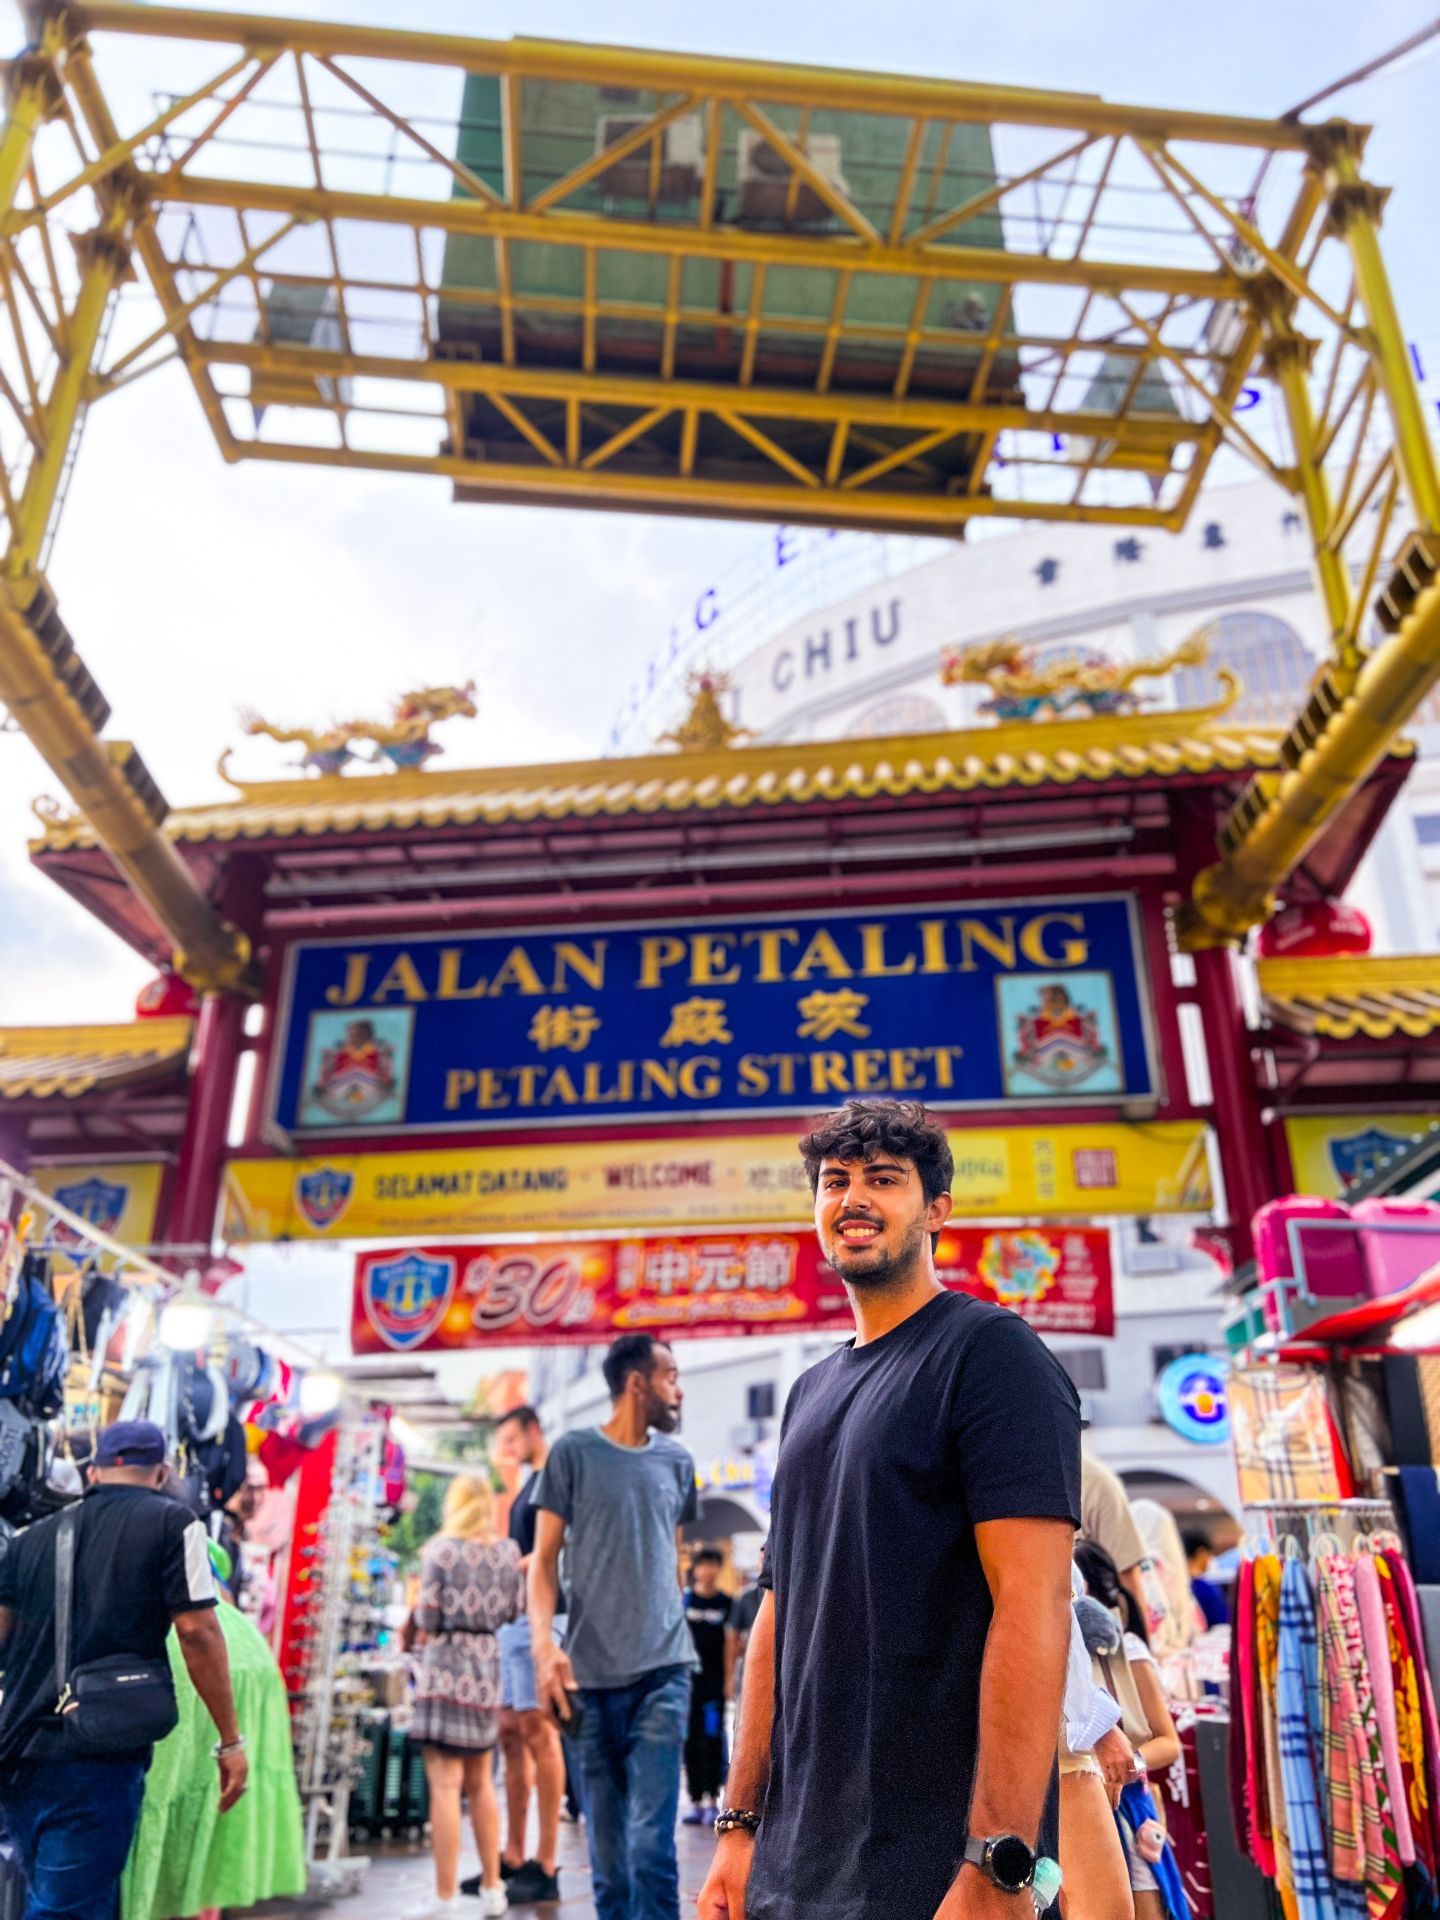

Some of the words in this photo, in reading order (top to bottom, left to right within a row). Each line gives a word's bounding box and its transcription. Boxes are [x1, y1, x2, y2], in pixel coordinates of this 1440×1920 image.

[771, 598, 904, 692] CHIU
[325, 938, 608, 1006] JALAN
[636, 911, 1089, 989] PETALING
[444, 1055, 722, 1111] PETALING
[736, 1045, 963, 1097] STREET
[374, 1170, 475, 1200] SELAMAT
[478, 1166, 569, 1195] DATANG
[606, 1160, 714, 1191] WELCOME
